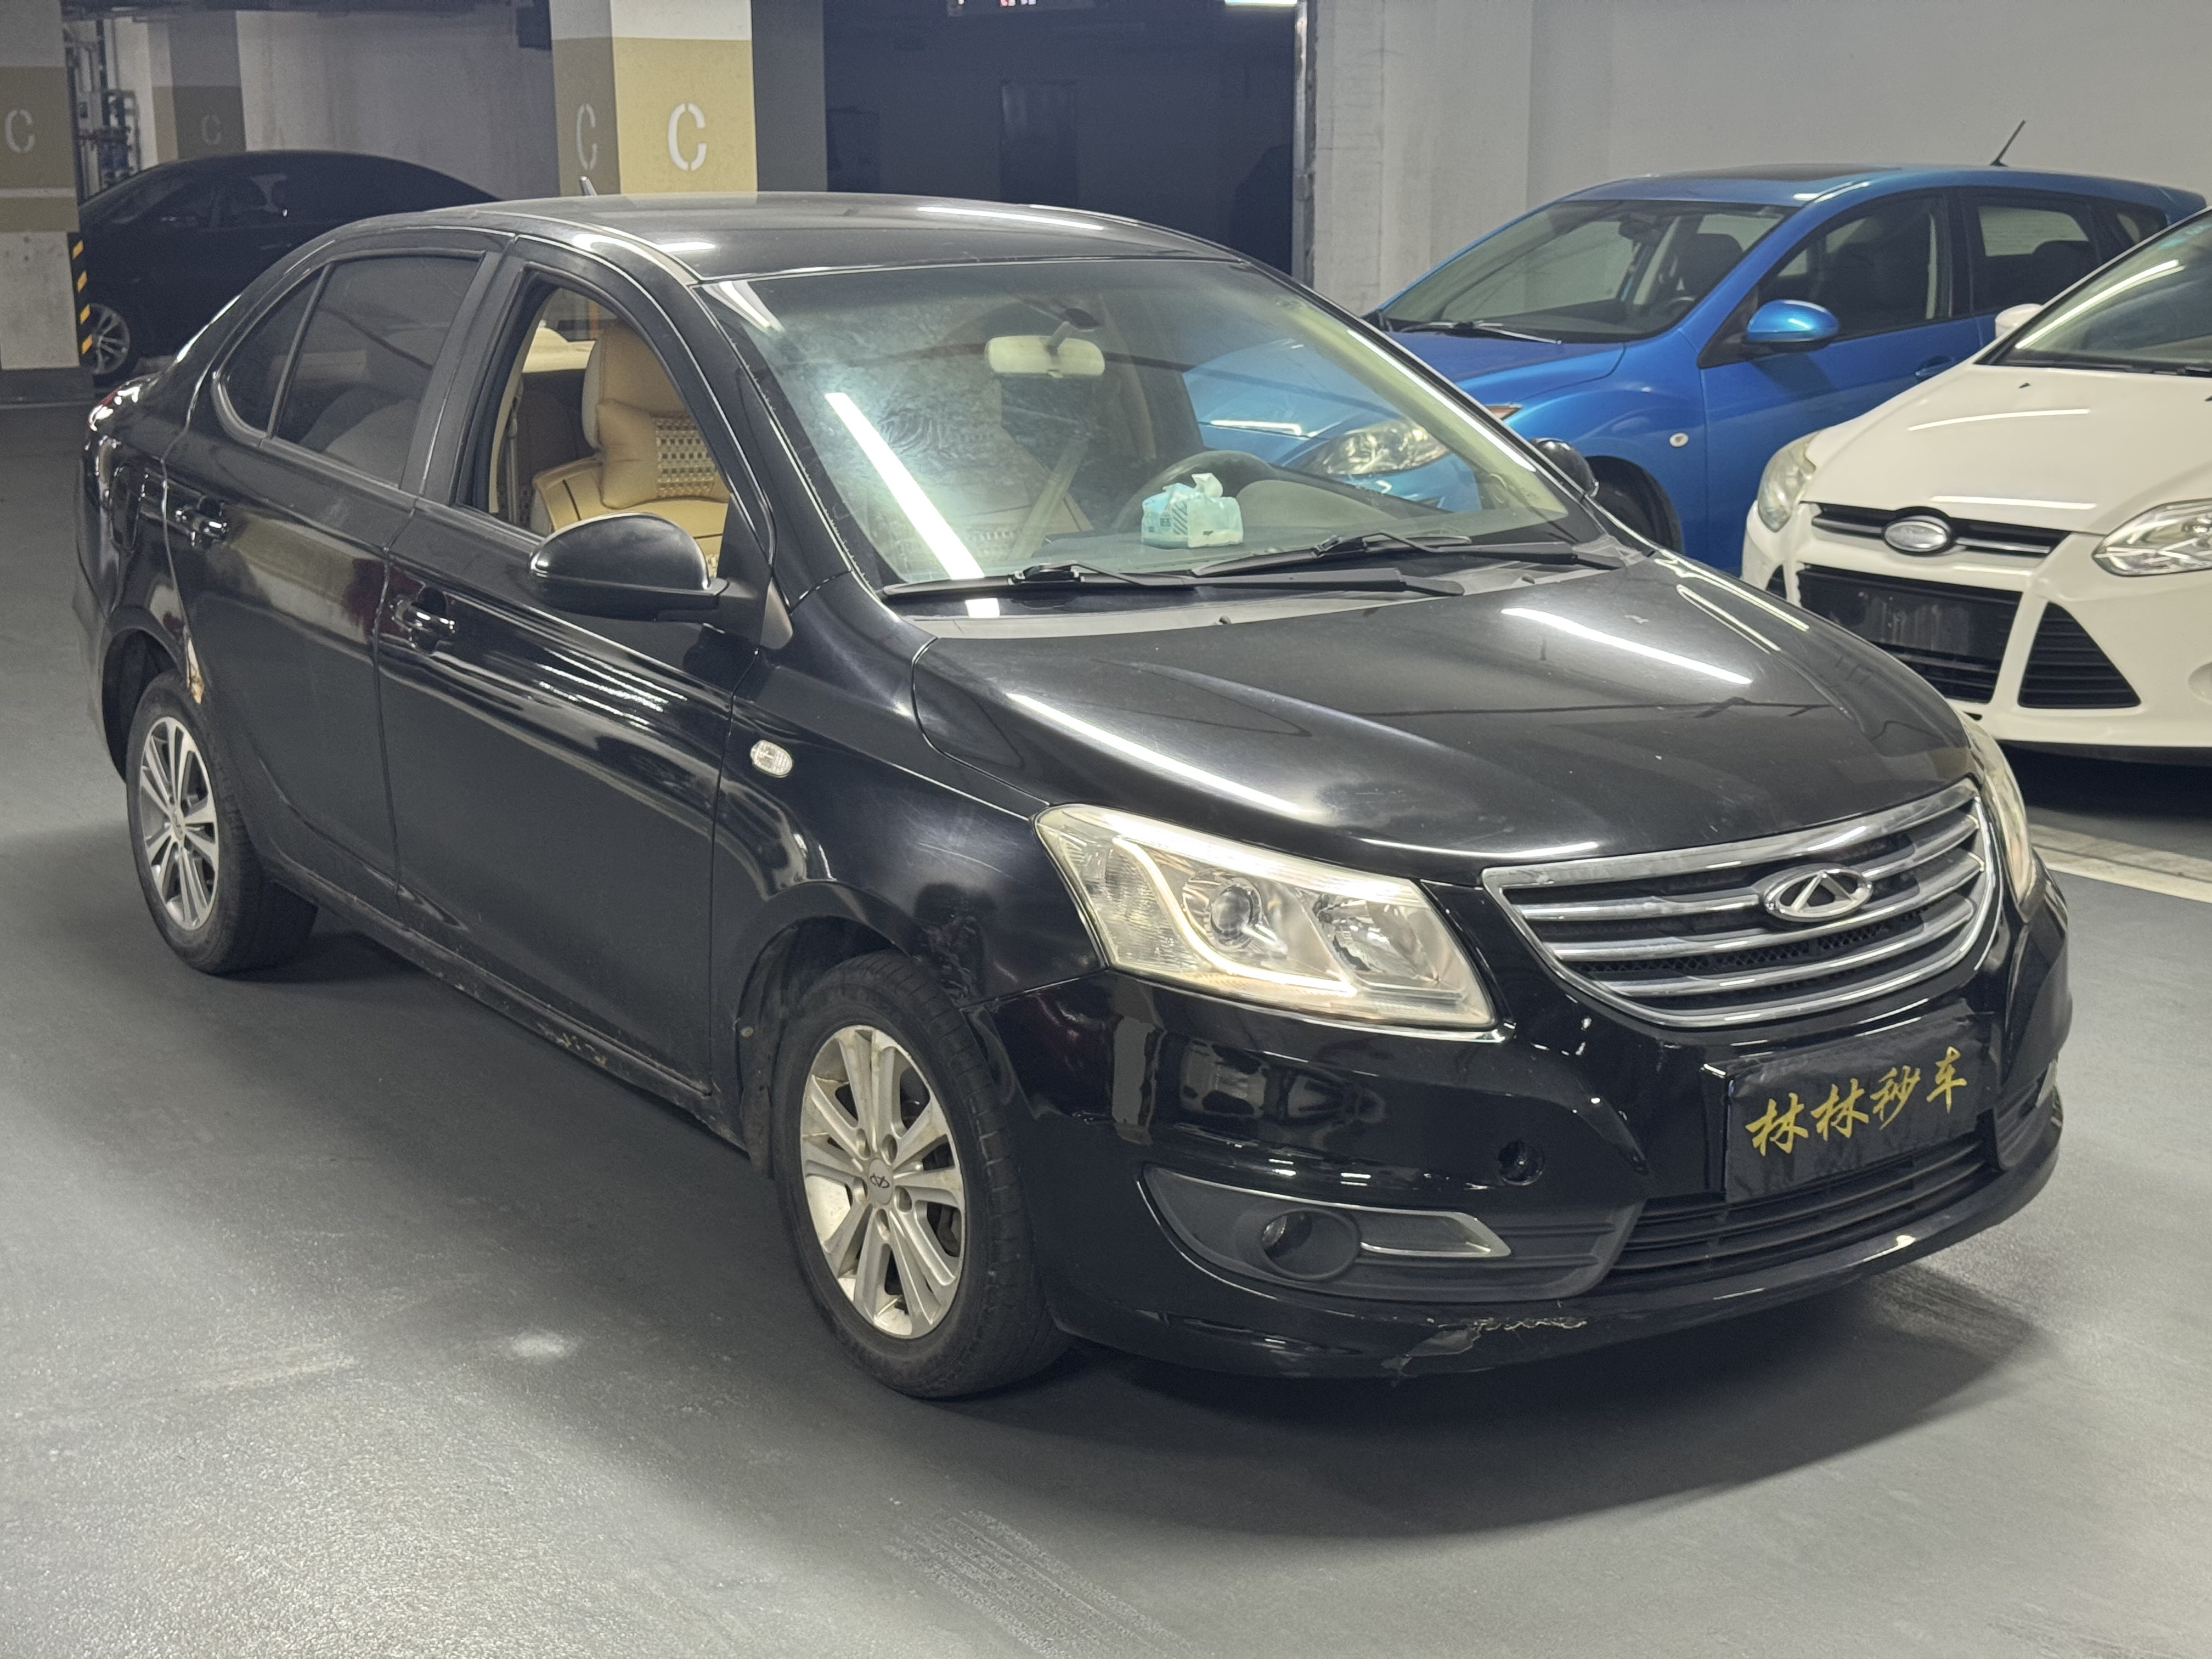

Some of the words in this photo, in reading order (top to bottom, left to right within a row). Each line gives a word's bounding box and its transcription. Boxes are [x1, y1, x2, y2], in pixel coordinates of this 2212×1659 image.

[5, 109, 35, 154] C
[201, 114, 222, 146] C
[576, 103, 597, 171] C
[668, 103, 707, 171] C
[1745, 1046, 1967, 1156] 林林秒车
